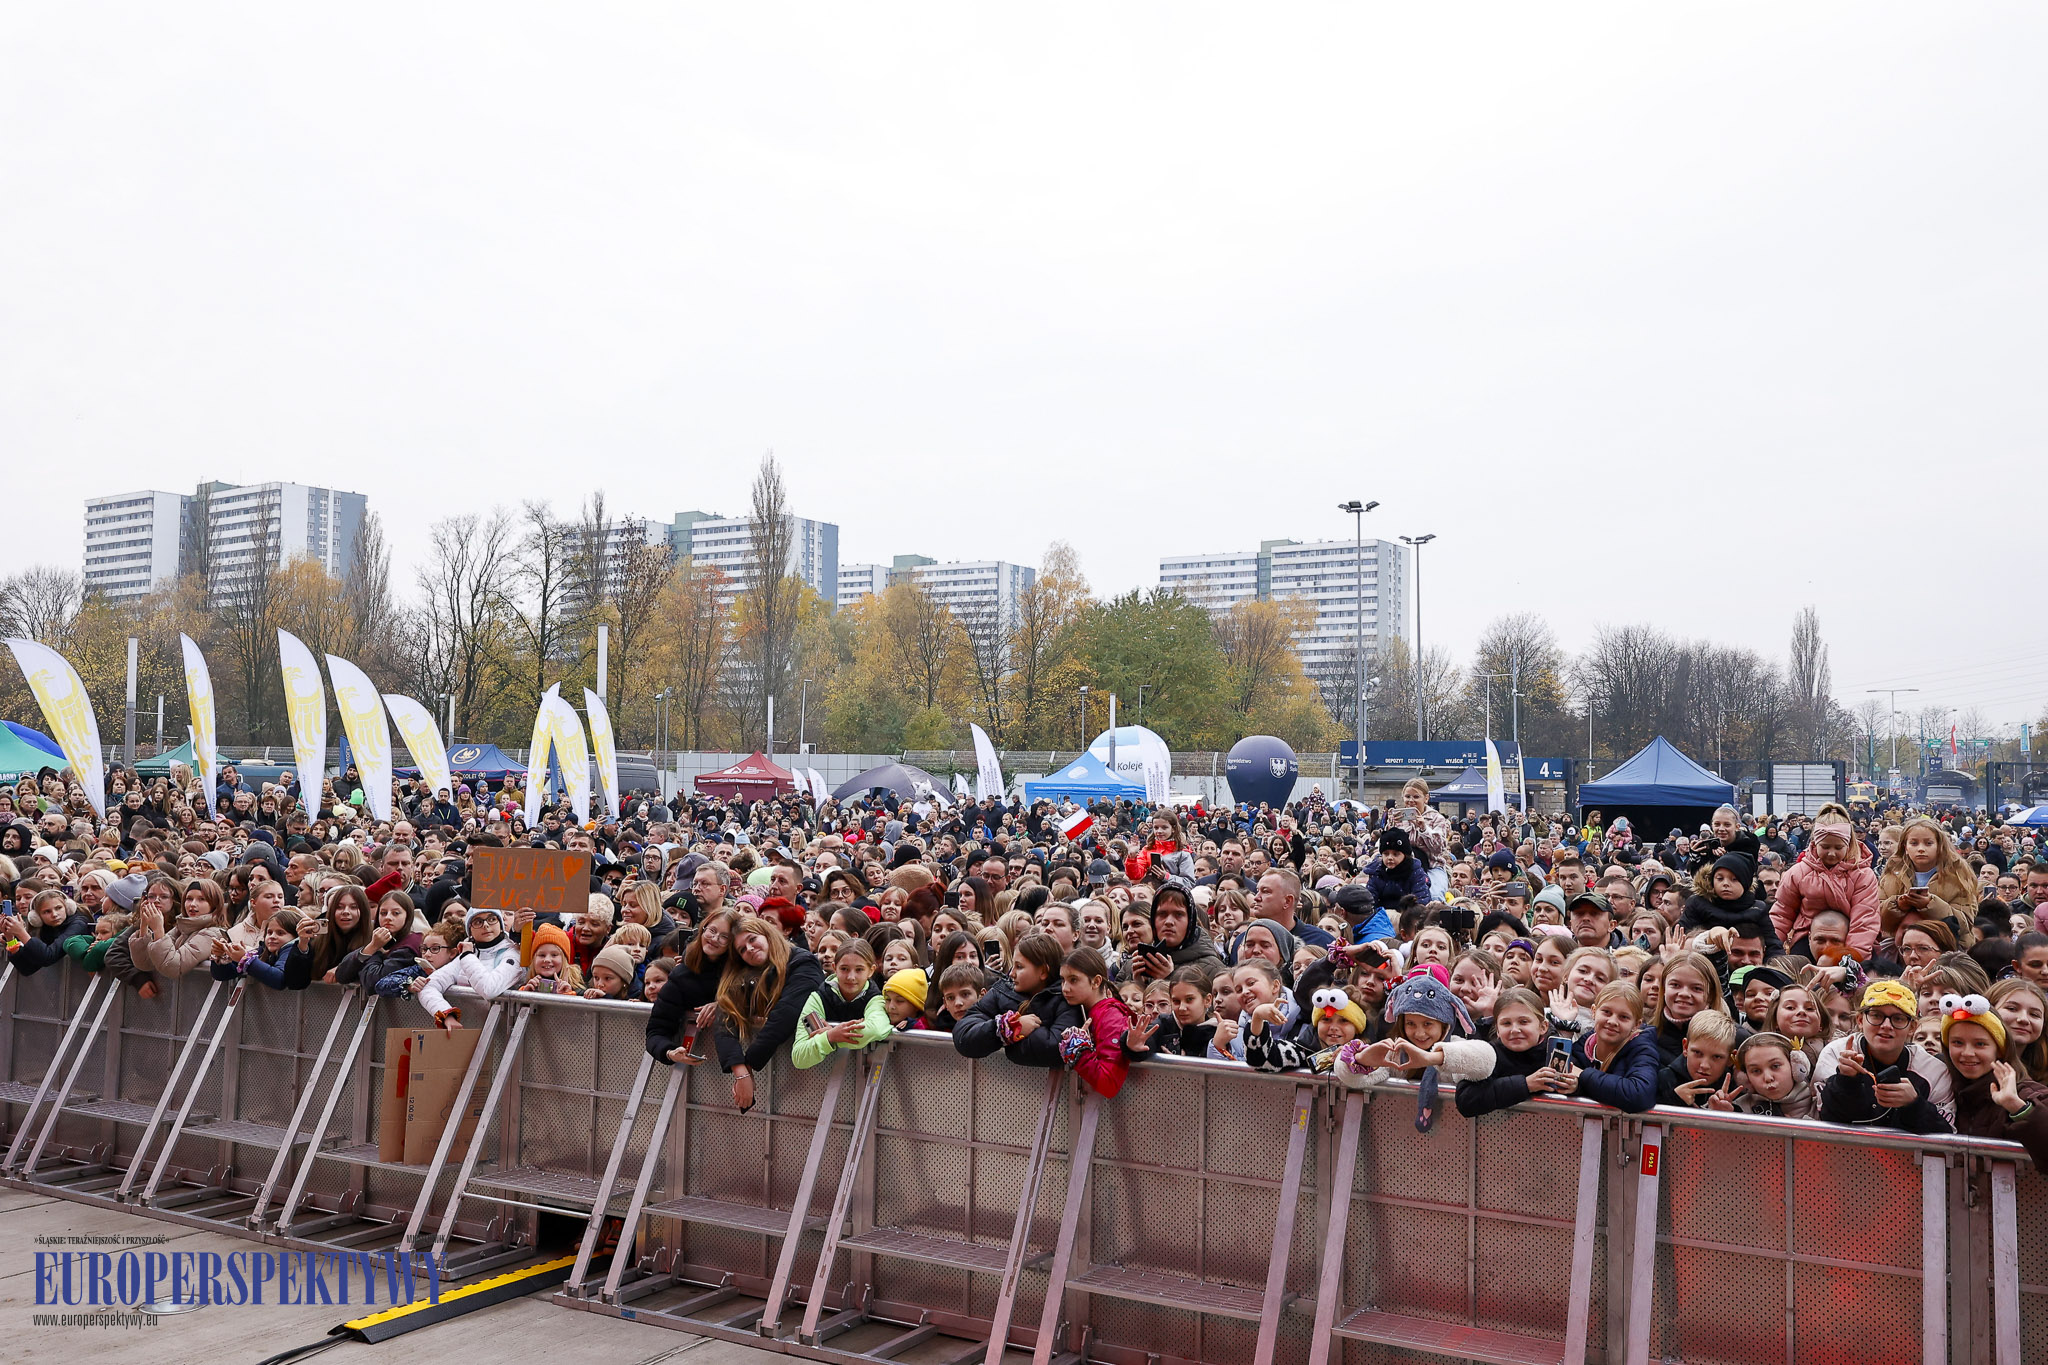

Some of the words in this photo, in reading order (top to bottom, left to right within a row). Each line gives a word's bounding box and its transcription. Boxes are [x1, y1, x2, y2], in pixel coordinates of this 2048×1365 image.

[1117, 761, 1143, 771] Koleje
[1539, 762, 1550, 778] 4
[479, 852, 555, 882] JULIA
[477, 883, 566, 910] ŻUGAJ
